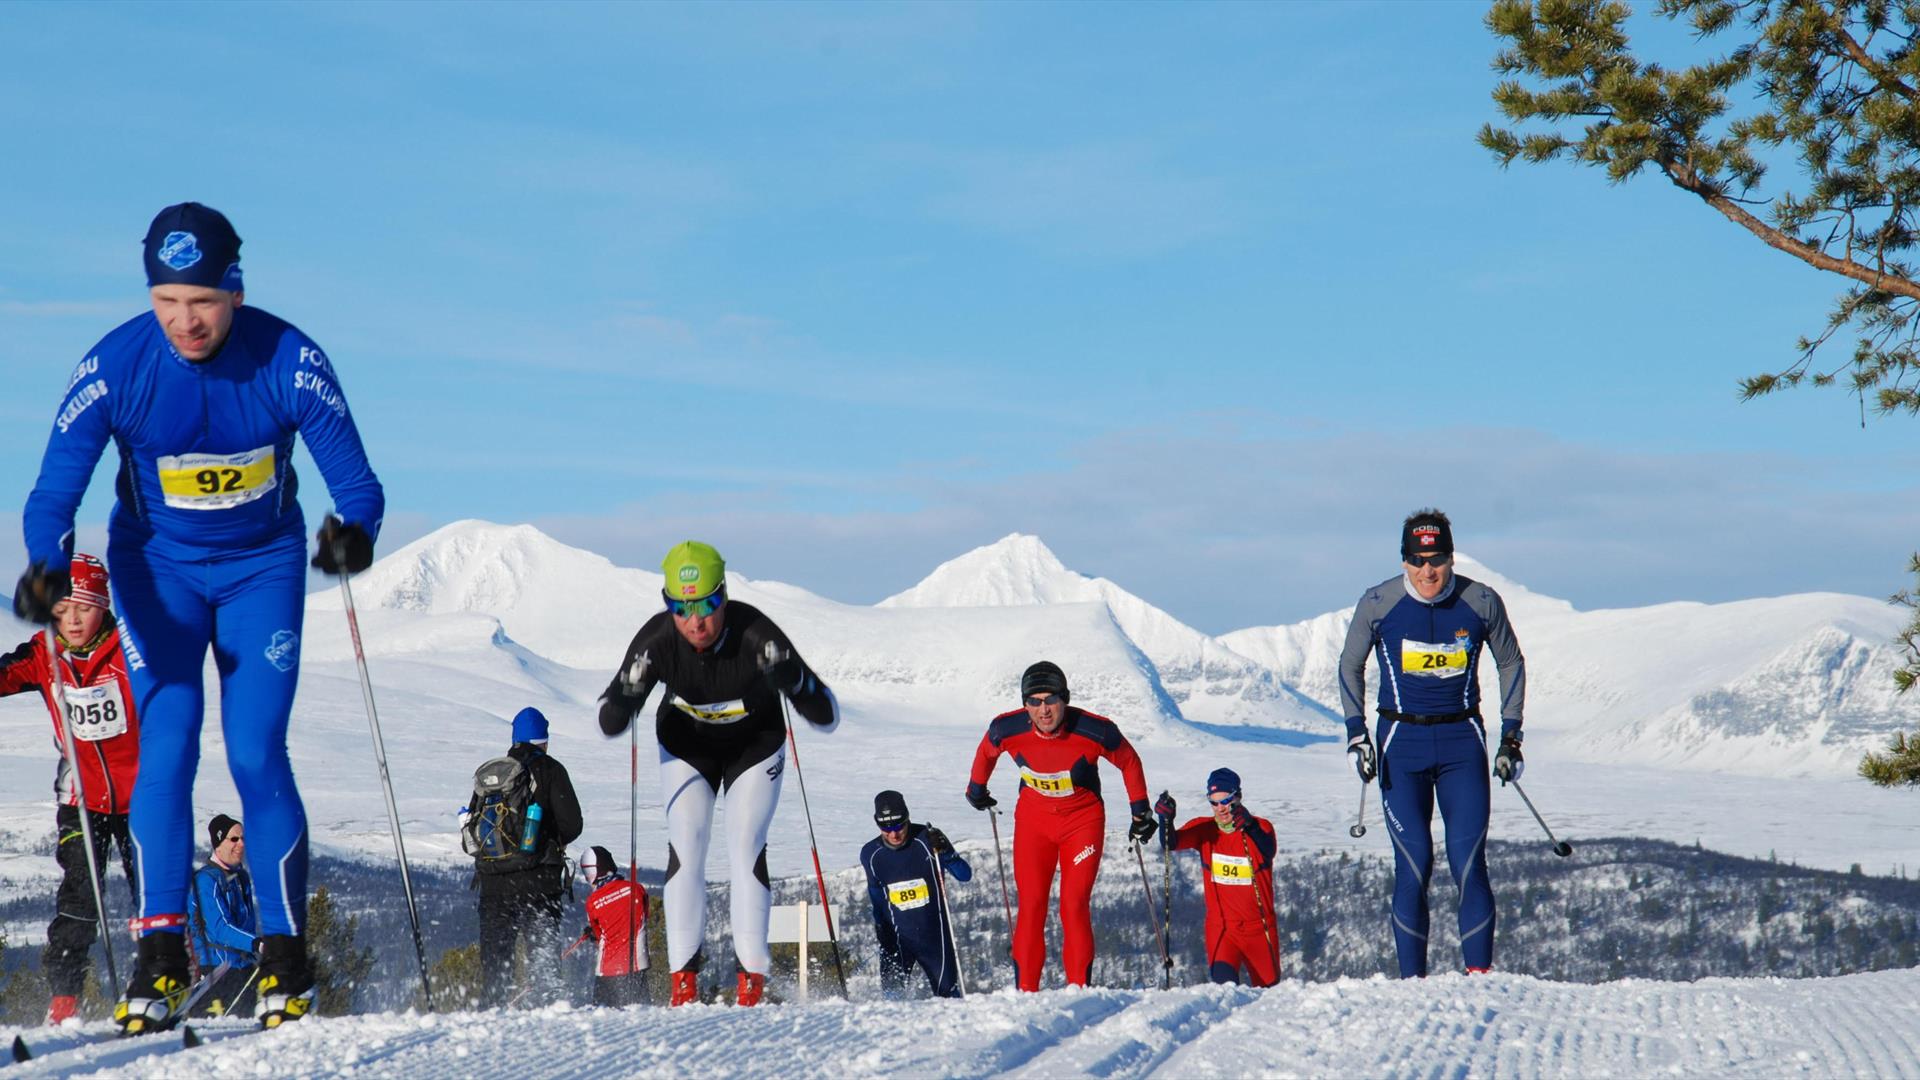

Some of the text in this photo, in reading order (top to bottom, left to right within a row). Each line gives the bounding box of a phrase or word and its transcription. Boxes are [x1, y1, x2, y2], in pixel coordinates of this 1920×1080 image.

[196, 469, 245, 494] 92
[117, 616, 146, 671] TRIMTEX
[1422, 654, 1448, 669] 28
[1030, 777, 1060, 791] 151
[1222, 864, 1239, 877] 94
[899, 889, 917, 902] 89
